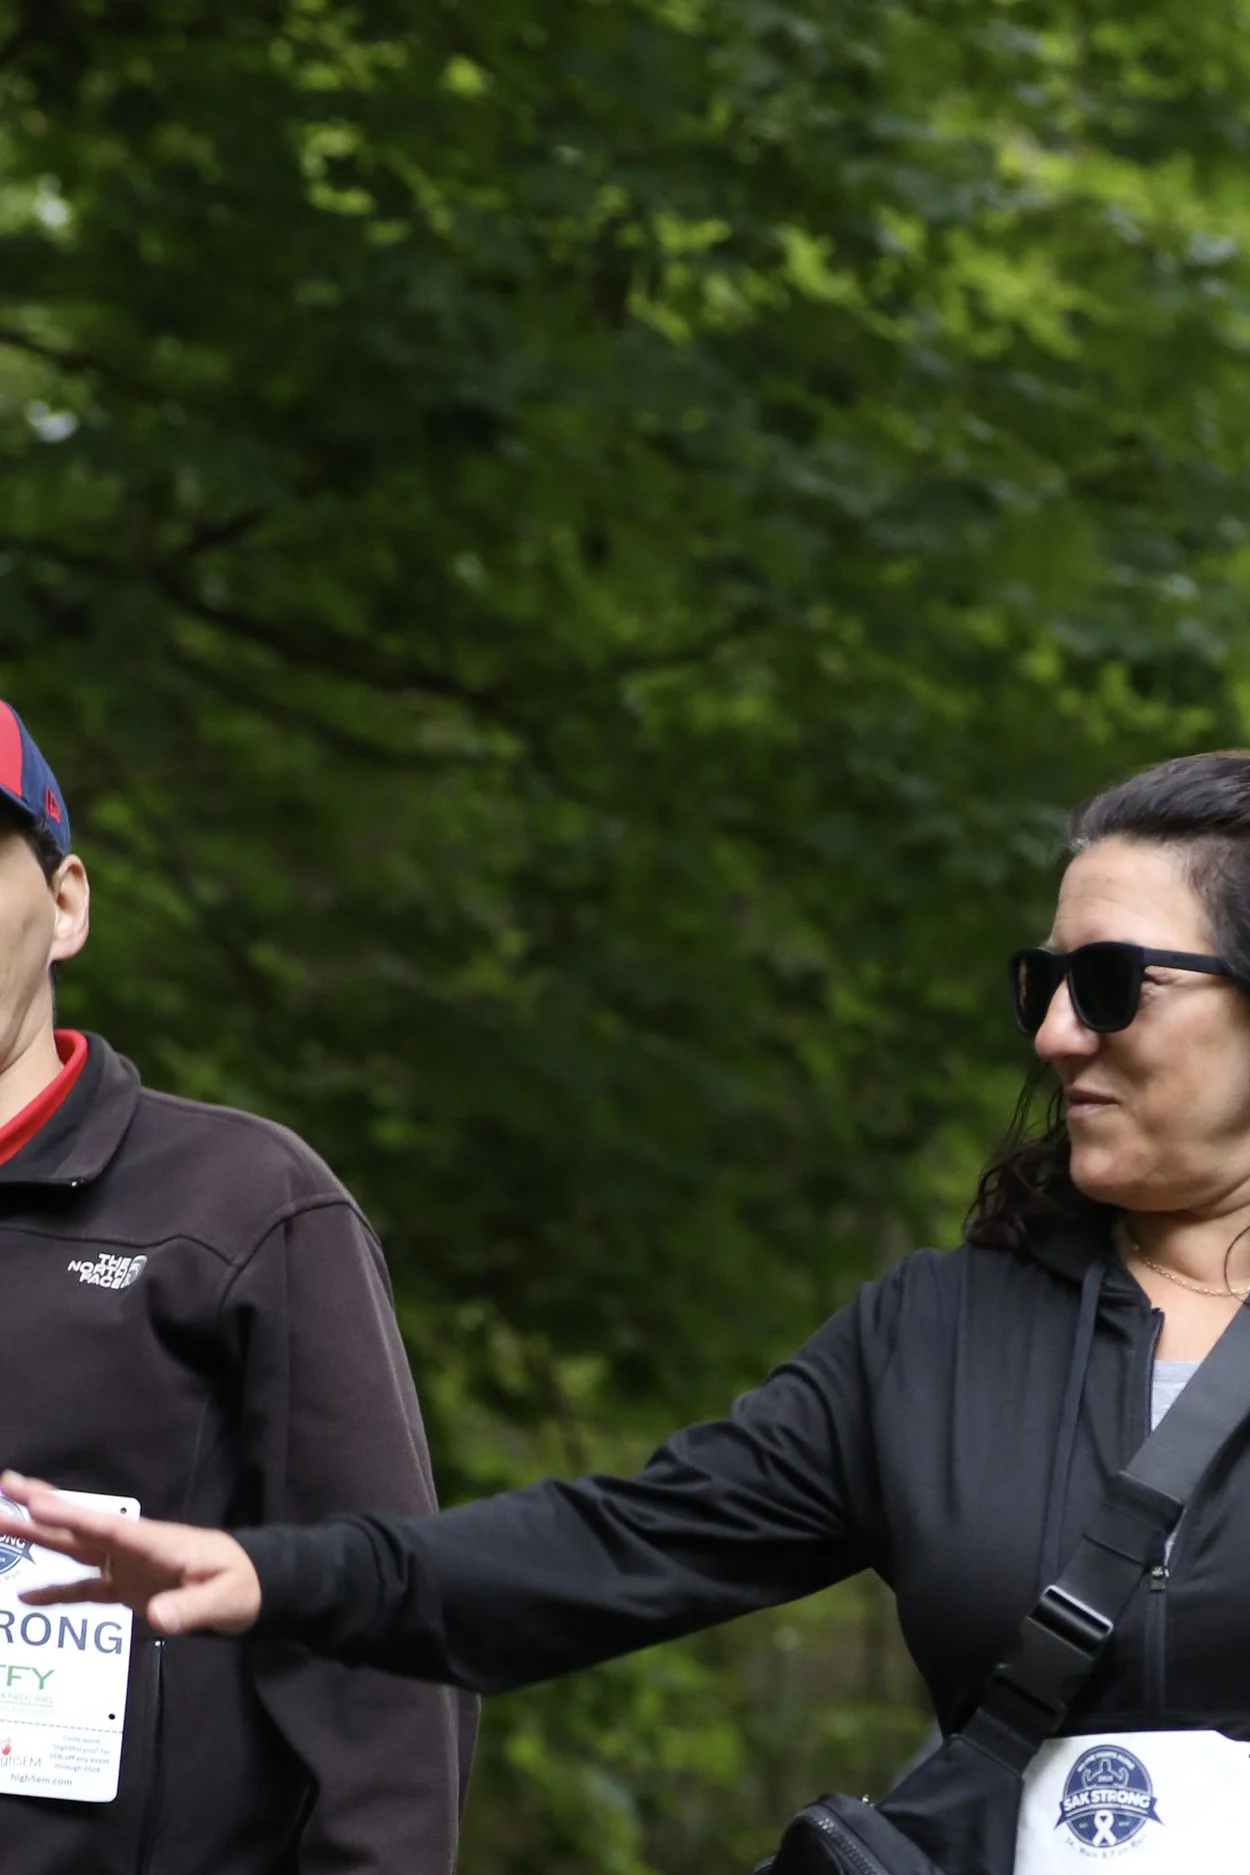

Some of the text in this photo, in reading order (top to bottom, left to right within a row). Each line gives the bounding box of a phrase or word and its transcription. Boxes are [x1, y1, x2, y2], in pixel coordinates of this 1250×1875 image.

[67, 1260, 128, 1279] NORTH
[99, 1253, 132, 1270] THE
[79, 1271, 121, 1289] FACE
[1090, 1790, 1151, 1809] STRONG
